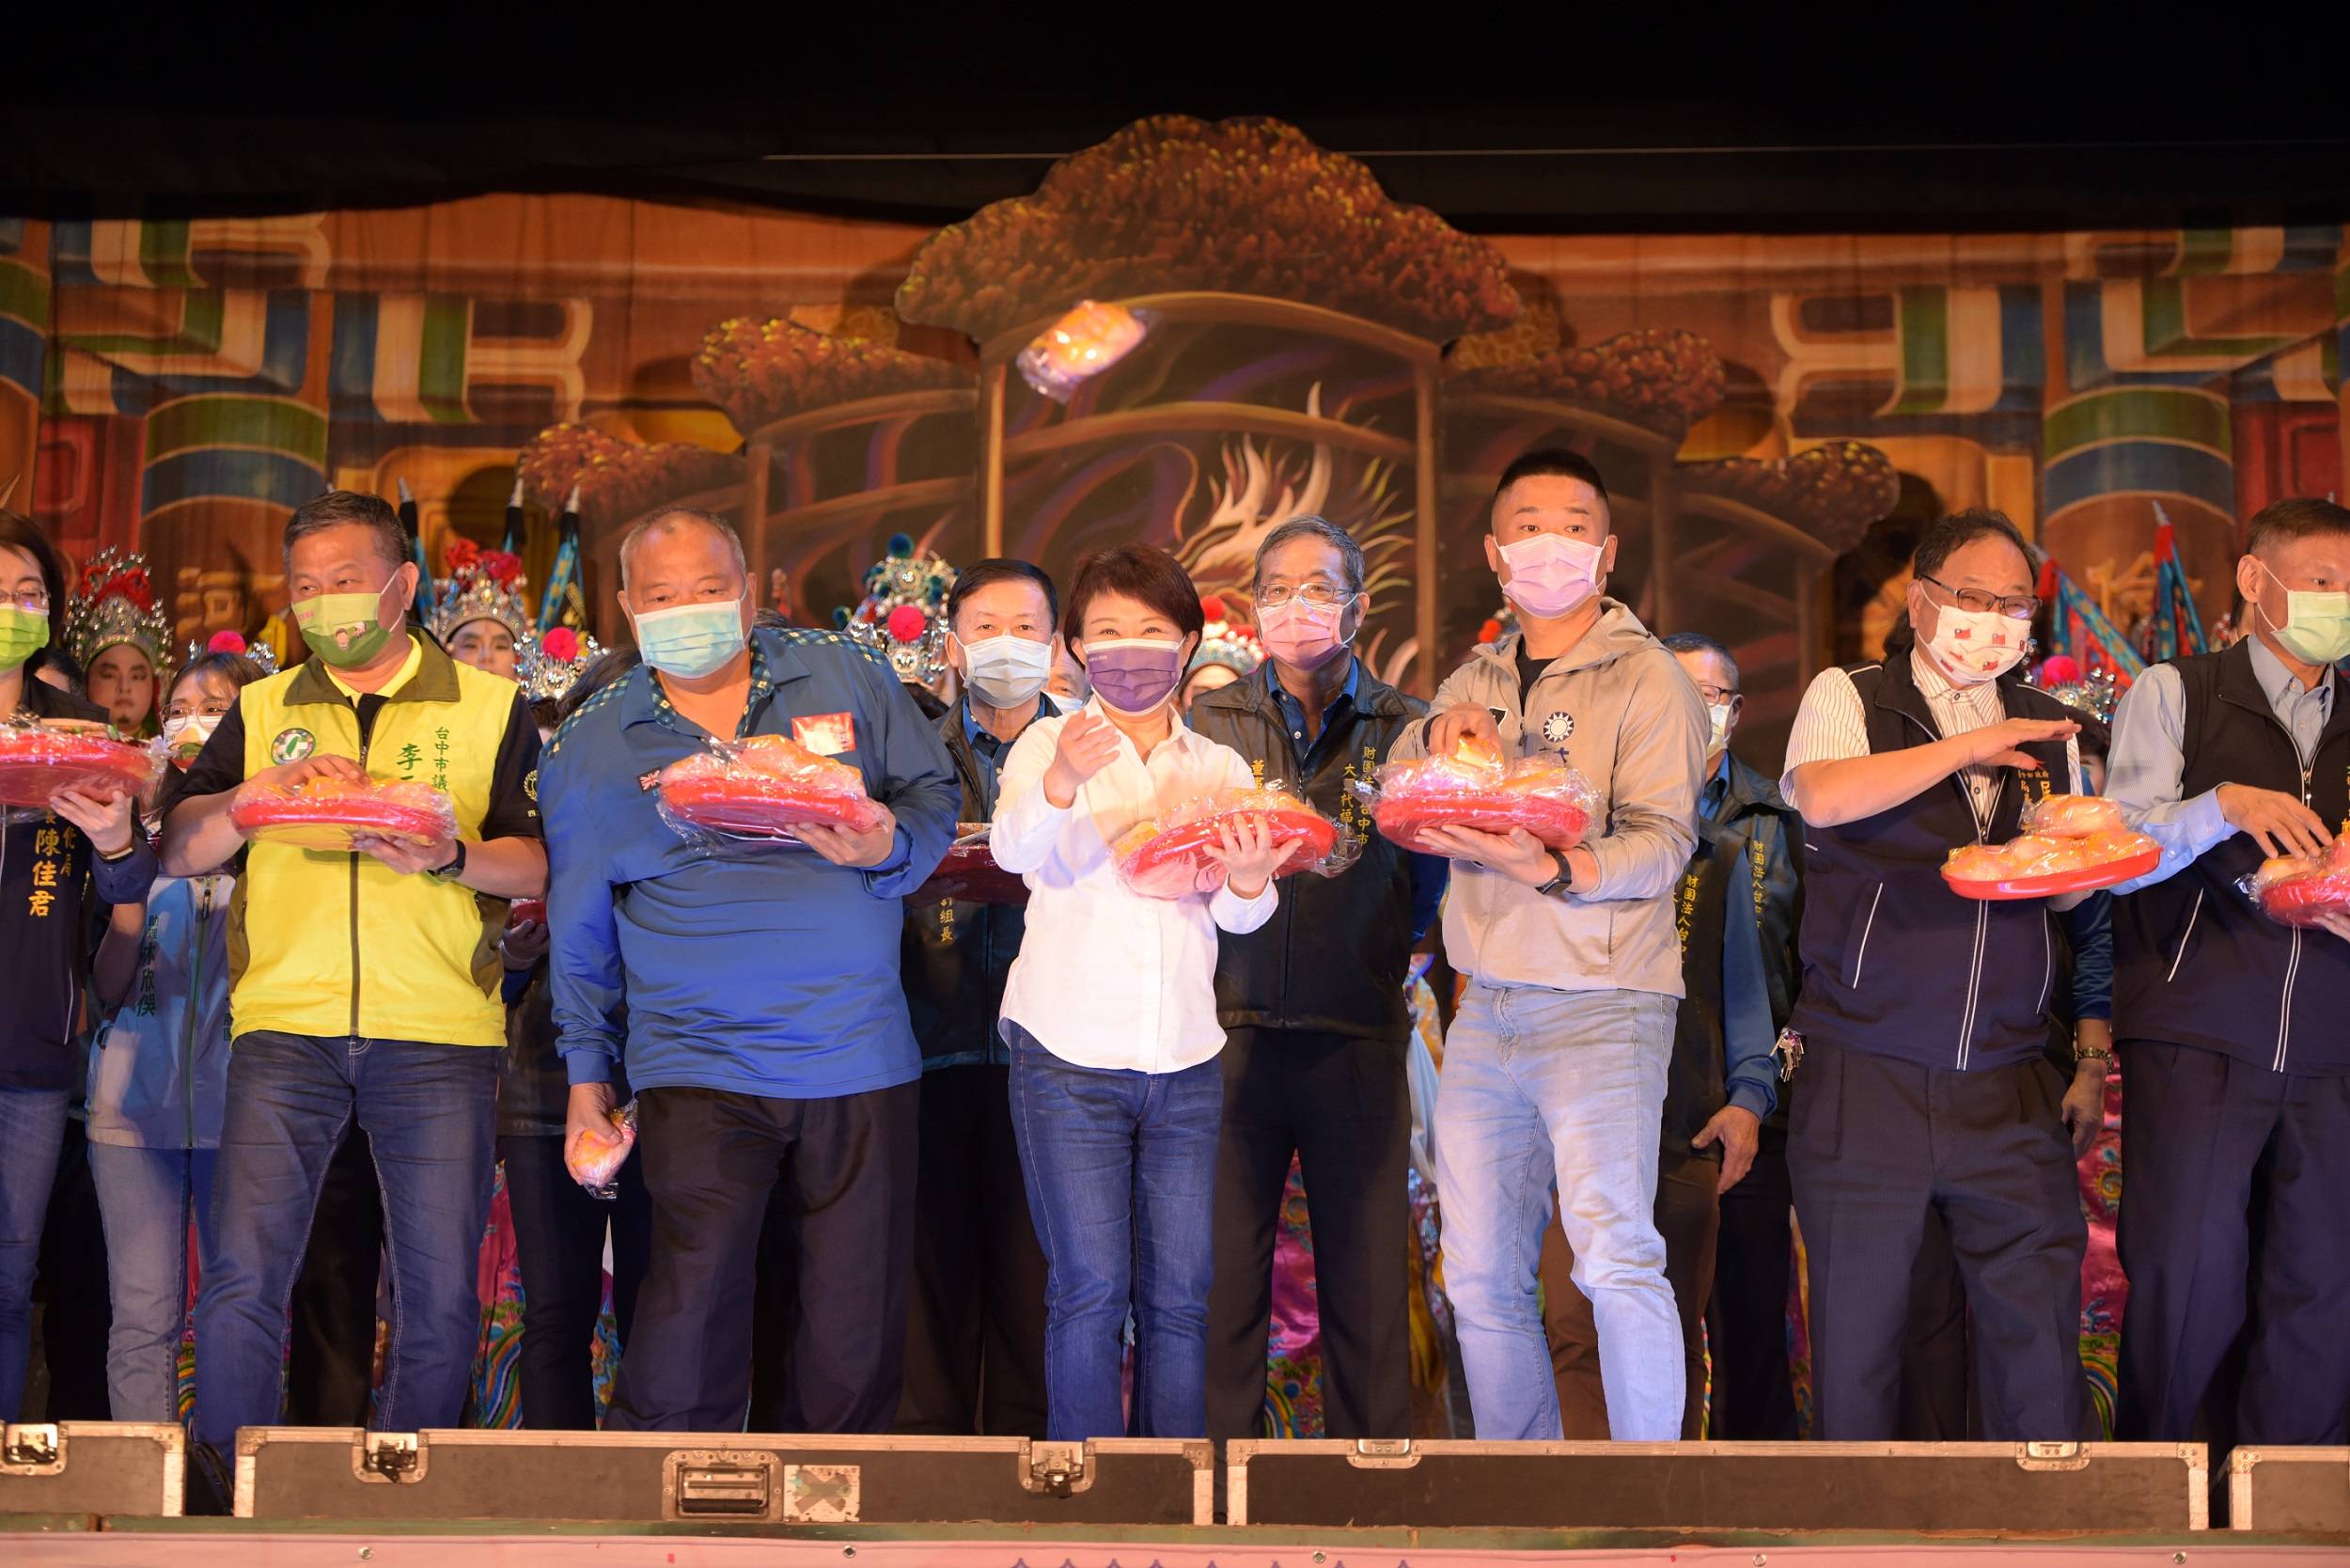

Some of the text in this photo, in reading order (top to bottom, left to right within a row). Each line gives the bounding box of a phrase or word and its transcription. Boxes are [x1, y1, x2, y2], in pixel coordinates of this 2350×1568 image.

[396, 743, 423, 780] 李
[431, 726, 449, 792] 台中市議
[1356, 746, 1376, 845] 財團法台中市
[28, 827, 61, 917] 陳佳君
